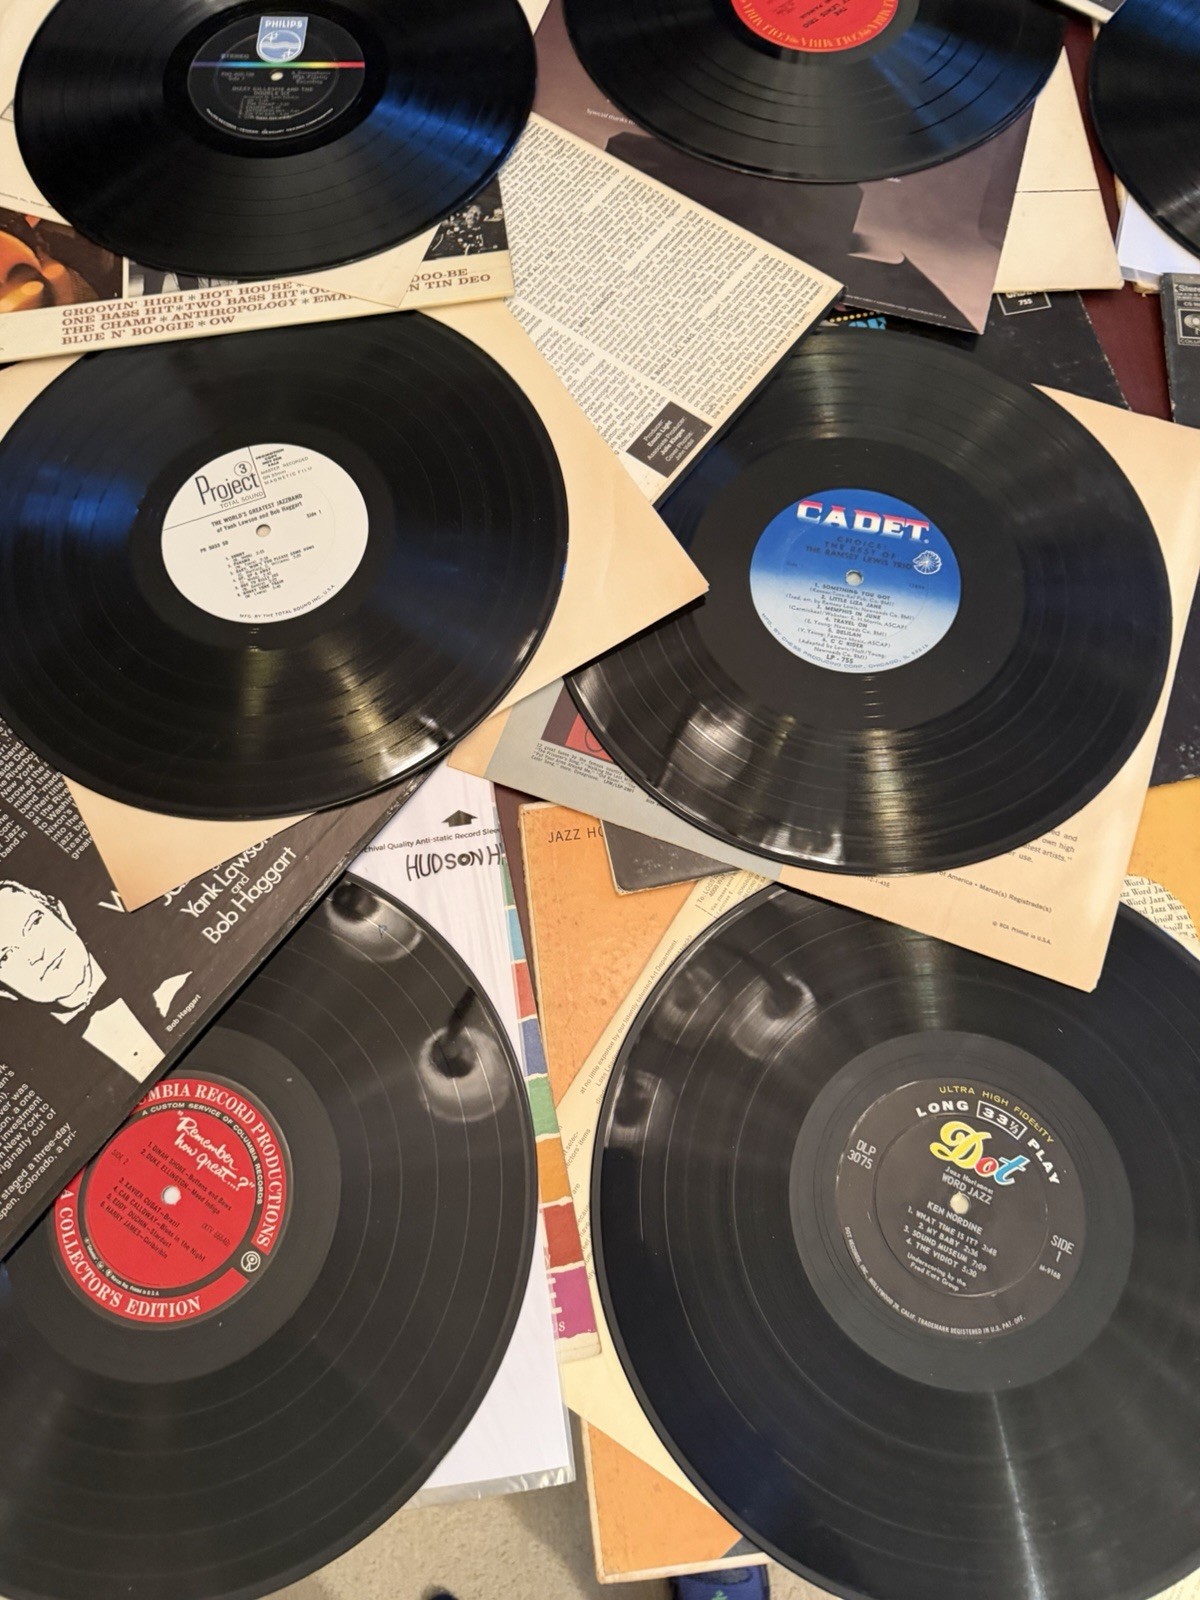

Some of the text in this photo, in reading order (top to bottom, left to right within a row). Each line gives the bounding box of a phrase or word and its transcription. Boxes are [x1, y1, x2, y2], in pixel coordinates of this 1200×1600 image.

[265, 20, 302, 29] PHILIPS
[425, 274, 491, 291] TIN DEO
[62, 281, 292, 317] GROOVIN' HIGH HOT HOUSE
[62, 289, 299, 327] ONE BASS HIT TWO BASS HIT
[62, 294, 351, 335] THE CHAMP ANTHROPOLOGY EMA
[61, 315, 235, 346] BLUE N' BOOGIE OW
[239, 463, 247, 474] 3
[264, 471, 296, 485] MAGNETIC
[195, 473, 260, 505] Project
[220, 492, 264, 509] TOTAL SOUND
[223, 512, 247, 523] WORLD'S
[248, 503, 274, 515] GREATEST
[277, 493, 303, 506] JAZZBAND
[238, 517, 257, 526] Lawson
[282, 502, 302, 512] Haggart
[796, 498, 930, 543] CADET
[825, 549, 913, 569] RAMSEY LEWIS TRIO
[822, 584, 858, 594] SOMETHING
[825, 605, 881, 620] MEMPHIS JUNE
[866, 602, 882, 610] JANE
[834, 618, 855, 626] TRAVEL
[836, 629, 861, 638] DELILAH
[842, 656, 854, 664] 755
[0, 764, 35, 798] New York
[36, 770, 52, 784] that
[19, 794, 39, 814] band
[40, 803, 53, 817] the
[5, 824, 22, 842] Jazz
[44, 809, 72, 836] Nixon's
[51, 814, 80, 842] into the
[64, 828, 89, 853] heard
[387, 830, 480, 851] Quality Anti-static Record
[548, 826, 581, 844] JAZZ
[1064, 833, 1078, 842] and
[1, 838, 20, 858] band
[1018, 854, 1034, 862] use.
[1059, 843, 1075, 853] high
[406, 848, 484, 882] HUDSON
[231, 873, 250, 894] and
[947, 873, 973, 886] America
[1124, 878, 1144, 887] Word
[180, 882, 224, 918] Yank
[202, 846, 297, 944] Bob Haggart
[1126, 897, 1146, 906] Word
[1131, 887, 1151, 896] Word
[1012, 926, 1029, 936] Printed
[165, 994, 201, 1032] Bob Haggart
[12, 1083, 28, 1102] was
[19, 1089, 36, 1108] one
[2, 1096, 43, 1141] investment
[939, 1086, 1054, 1143] ULTRA HIGH FIDELITY
[5, 1115, 39, 1152] New York
[32, 1121, 47, 1137] out
[152, 1145, 169, 1161] DINAH
[174, 1132, 198, 1156] how
[856, 1139, 877, 1155] DLP
[915, 1100, 969, 1118] LONG
[1027, 1138, 1060, 1185] PLAY
[929, 1120, 1031, 1186] Dot
[1, 1122, 71, 1200] staged three-day
[150, 1102, 263, 1205] CUSTOM SERVICE COLUMBIA RECORDS
[847, 1149, 873, 1170] 3075
[18, 1154, 57, 1195] Colorado,
[197, 1084, 256, 1130] RECORD
[251, 1123, 282, 1248] PRODUCTIONS
[160, 1164, 189, 1190] ELLINGTON
[125, 1182, 143, 1199] XAVIER
[942, 1173, 967, 1192] WORD
[967, 1187, 993, 1205] JAZZ
[105, 1204, 140, 1237] HARRY JAMES
[130, 1198, 158, 1223] CALLOWAY
[927, 1201, 983, 1235] KEN NORDINE
[916, 1210, 956, 1235] WHAT TIME
[912, 1230, 968, 1262] SOUND MUSEUM
[926, 1227, 960, 1248] MY BABY
[1050, 1234, 1075, 1255] SIDE
[59, 1206, 123, 1308] COLLECTOR'S
[124, 1295, 202, 1318] EDITION
[916, 1241, 959, 1268] THE VIDIOT
[917, 1316, 982, 1336] TRADEMARK REGISTERED
